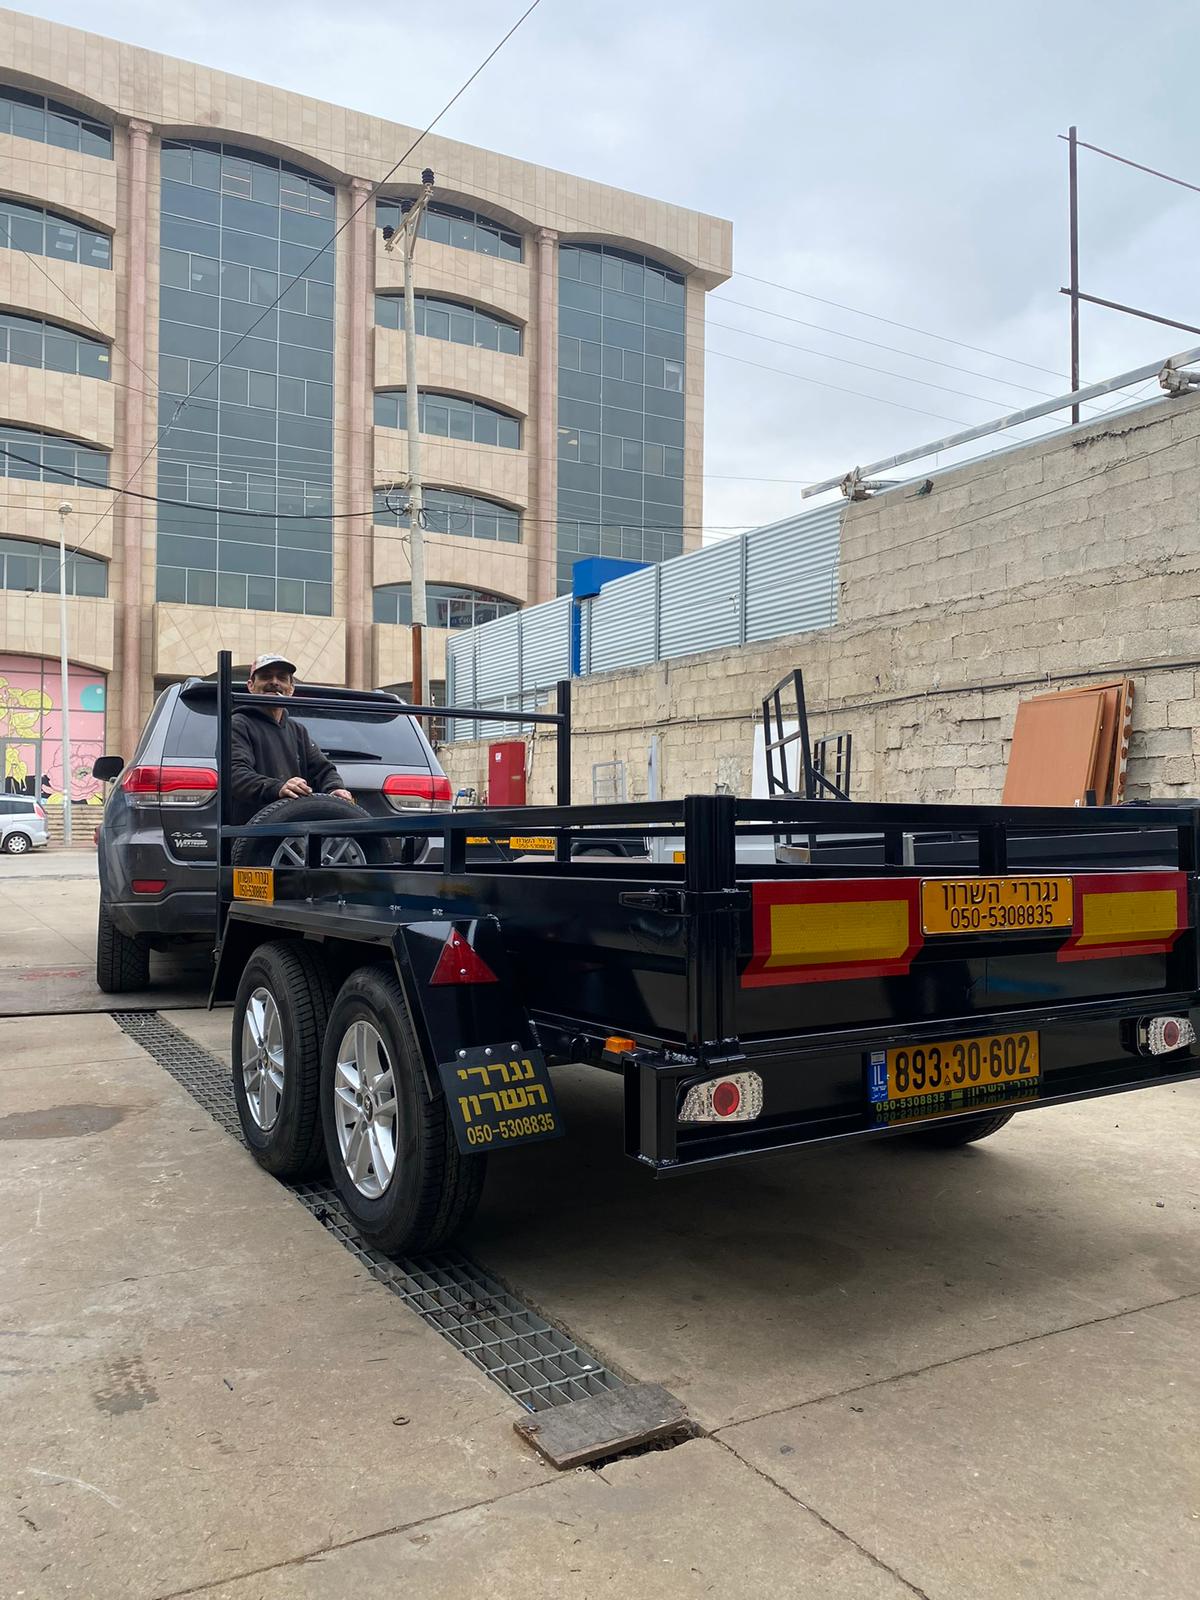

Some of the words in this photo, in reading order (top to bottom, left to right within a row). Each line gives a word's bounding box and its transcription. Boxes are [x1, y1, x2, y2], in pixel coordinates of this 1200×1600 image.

[941, 883, 1000, 911] השרון
[1012, 881, 1058, 902] נגררי
[950, 904, 1054, 929] 050-5308835
[457, 1059, 536, 1086] נגררי
[873, 1065, 884, 1085] IL
[458, 1083, 549, 1123] השרון
[466, 1112, 555, 1145] 050-5308835
